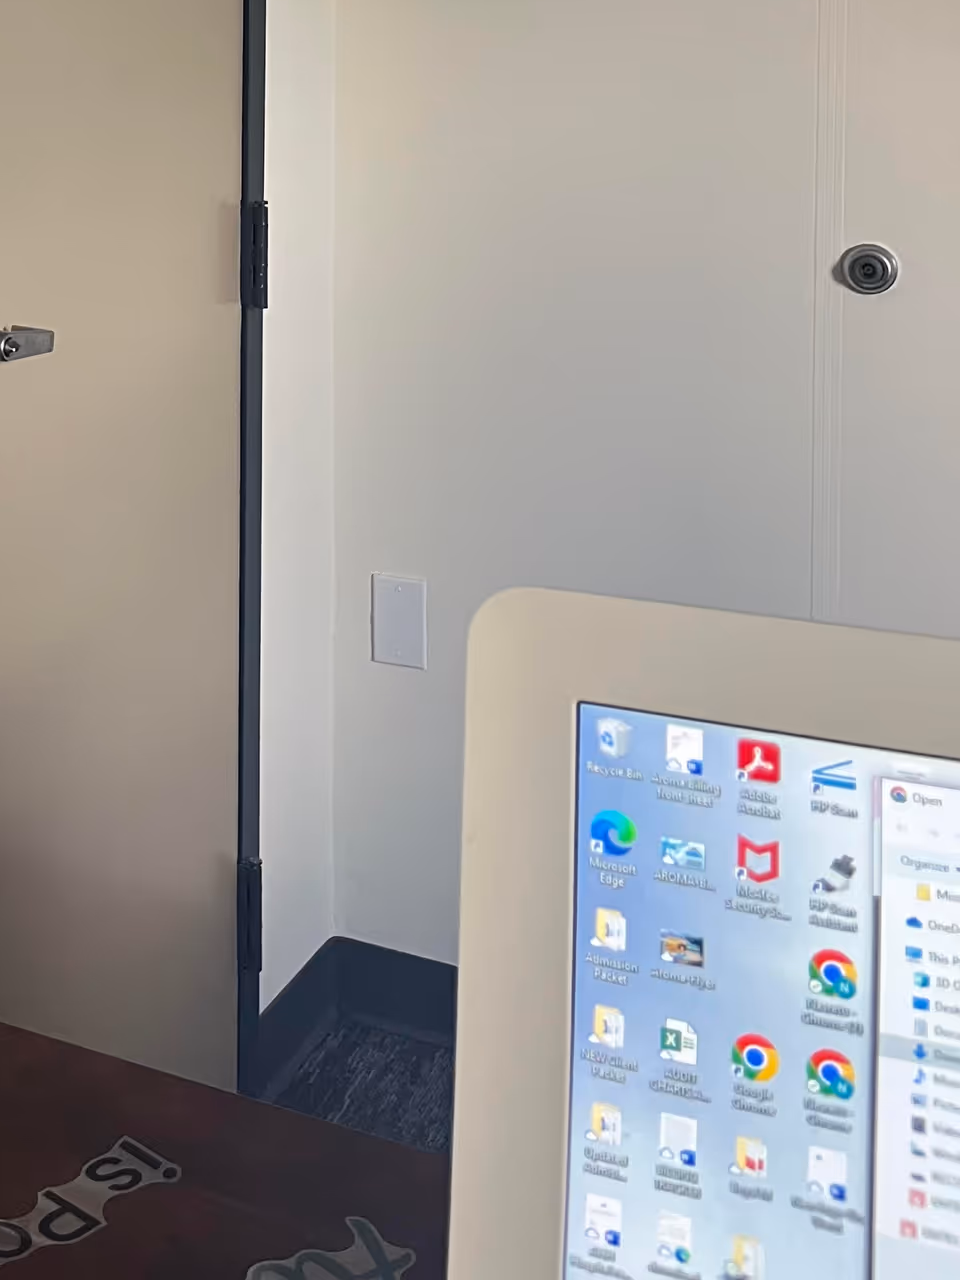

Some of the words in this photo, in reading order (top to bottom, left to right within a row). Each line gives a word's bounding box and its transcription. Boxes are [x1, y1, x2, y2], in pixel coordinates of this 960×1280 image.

[587, 761, 623, 777] Recycle
[627, 768, 642, 780] Bin
[912, 792, 942, 807] Open
[589, 857, 637, 875] Microsoft
[600, 873, 625, 888] Edge
